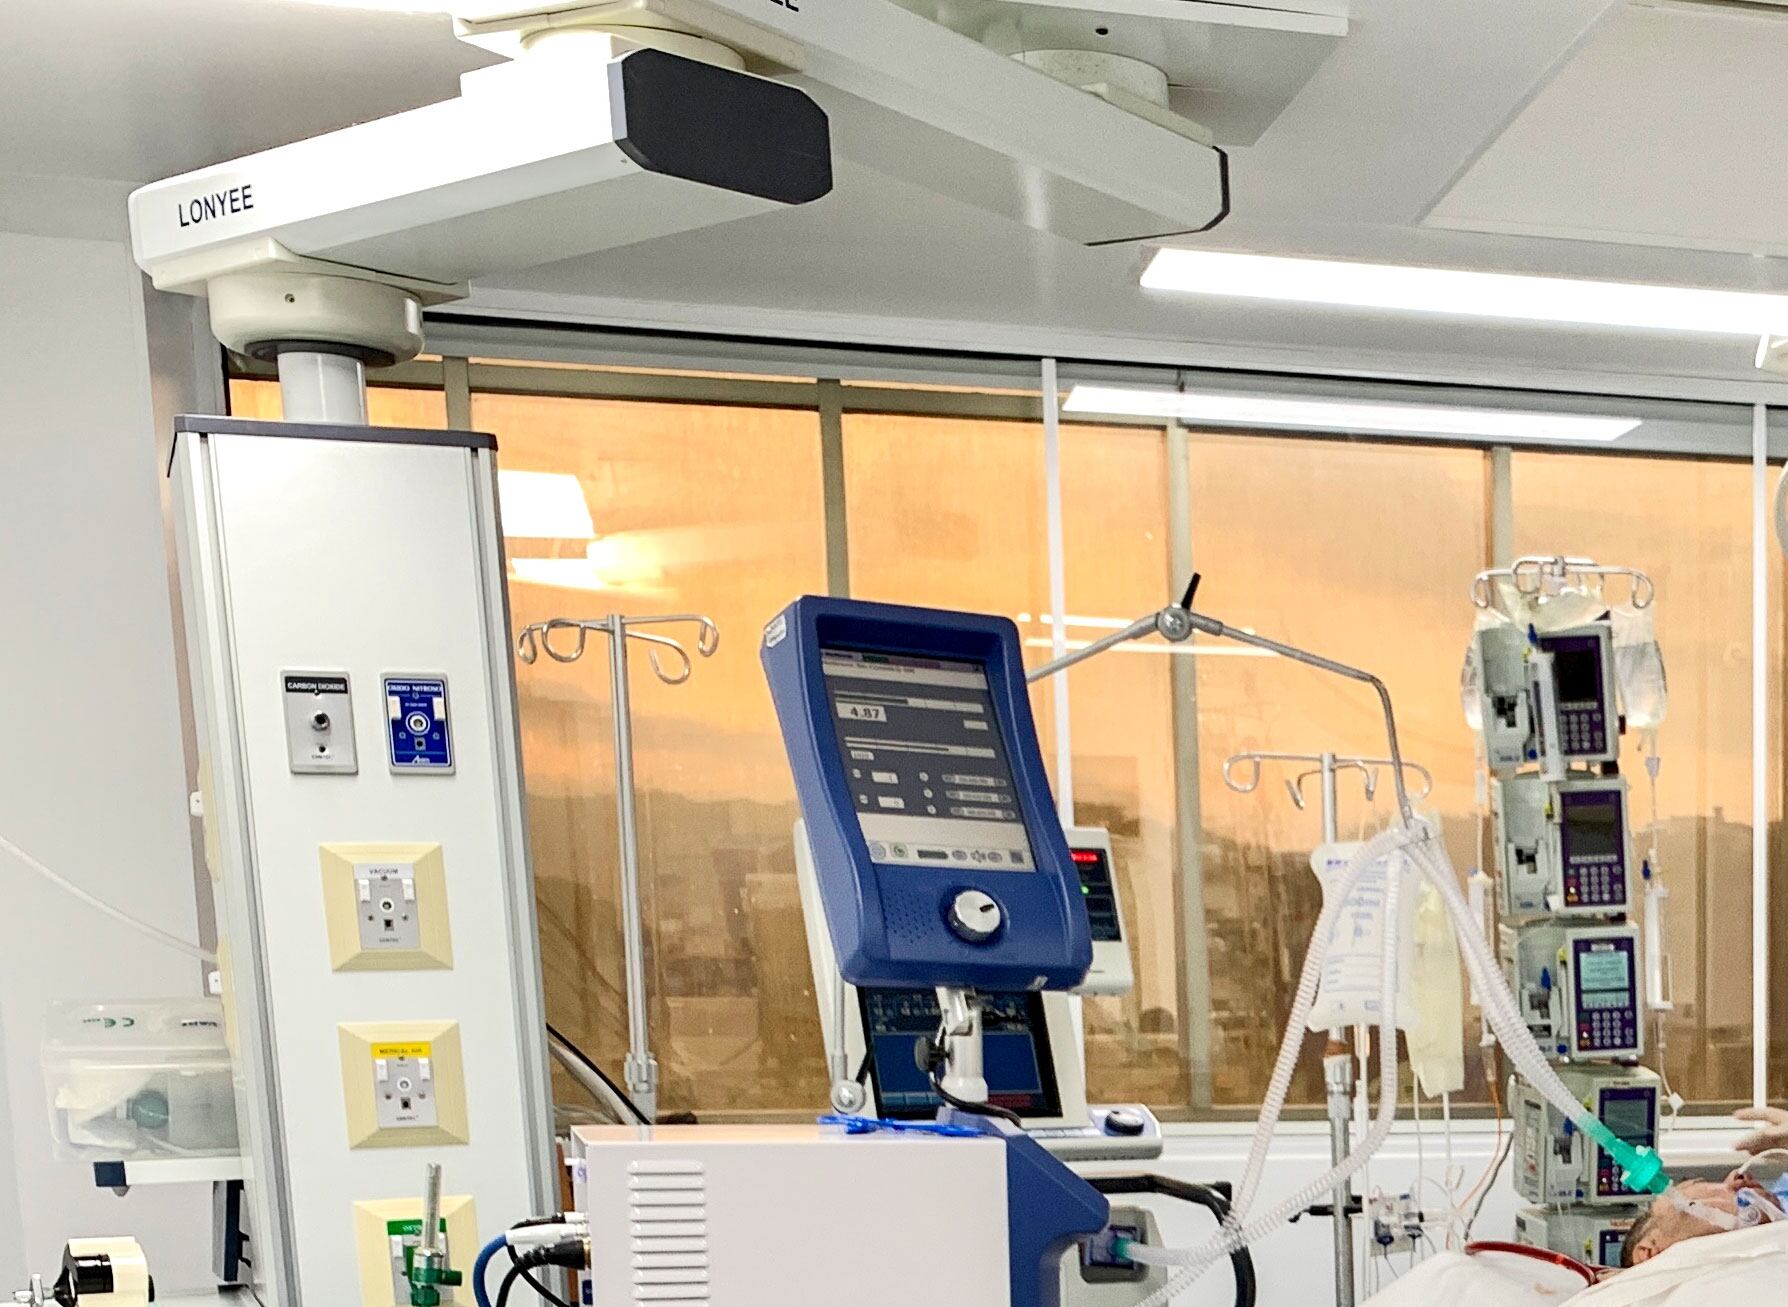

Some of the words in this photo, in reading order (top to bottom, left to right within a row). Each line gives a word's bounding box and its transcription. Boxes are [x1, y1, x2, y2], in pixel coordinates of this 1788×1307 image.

[178, 184, 254, 227] LONYEE
[287, 682, 317, 690] CARBON
[318, 682, 346, 691] DIOXIDE
[850, 707, 881, 719] 4.87
